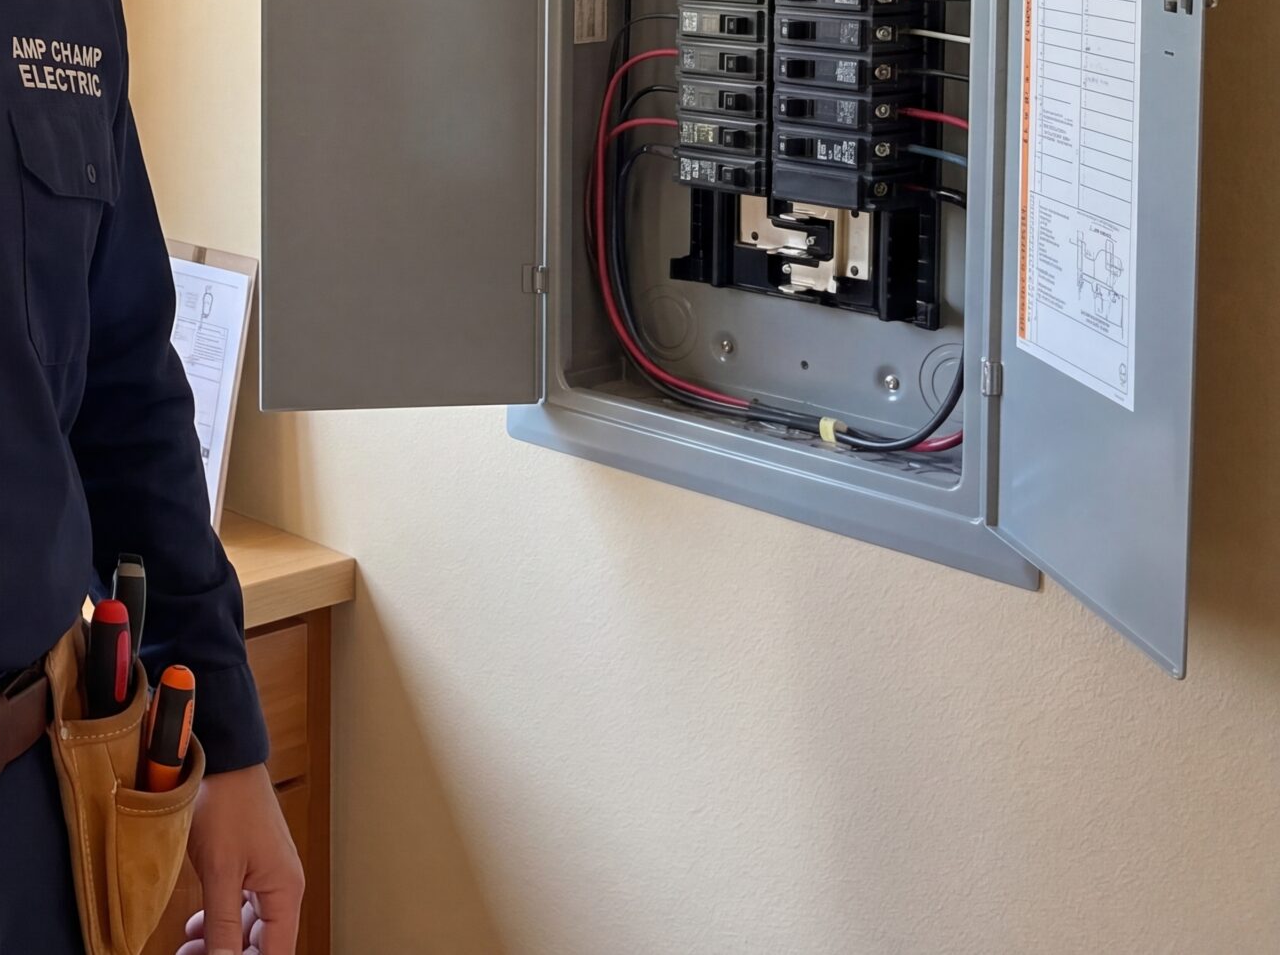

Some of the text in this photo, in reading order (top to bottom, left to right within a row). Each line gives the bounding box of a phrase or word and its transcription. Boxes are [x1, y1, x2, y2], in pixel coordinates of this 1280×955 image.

[12, 36, 102, 68] AMP CHAMP
[18, 64, 102, 98] ELECTRIC
